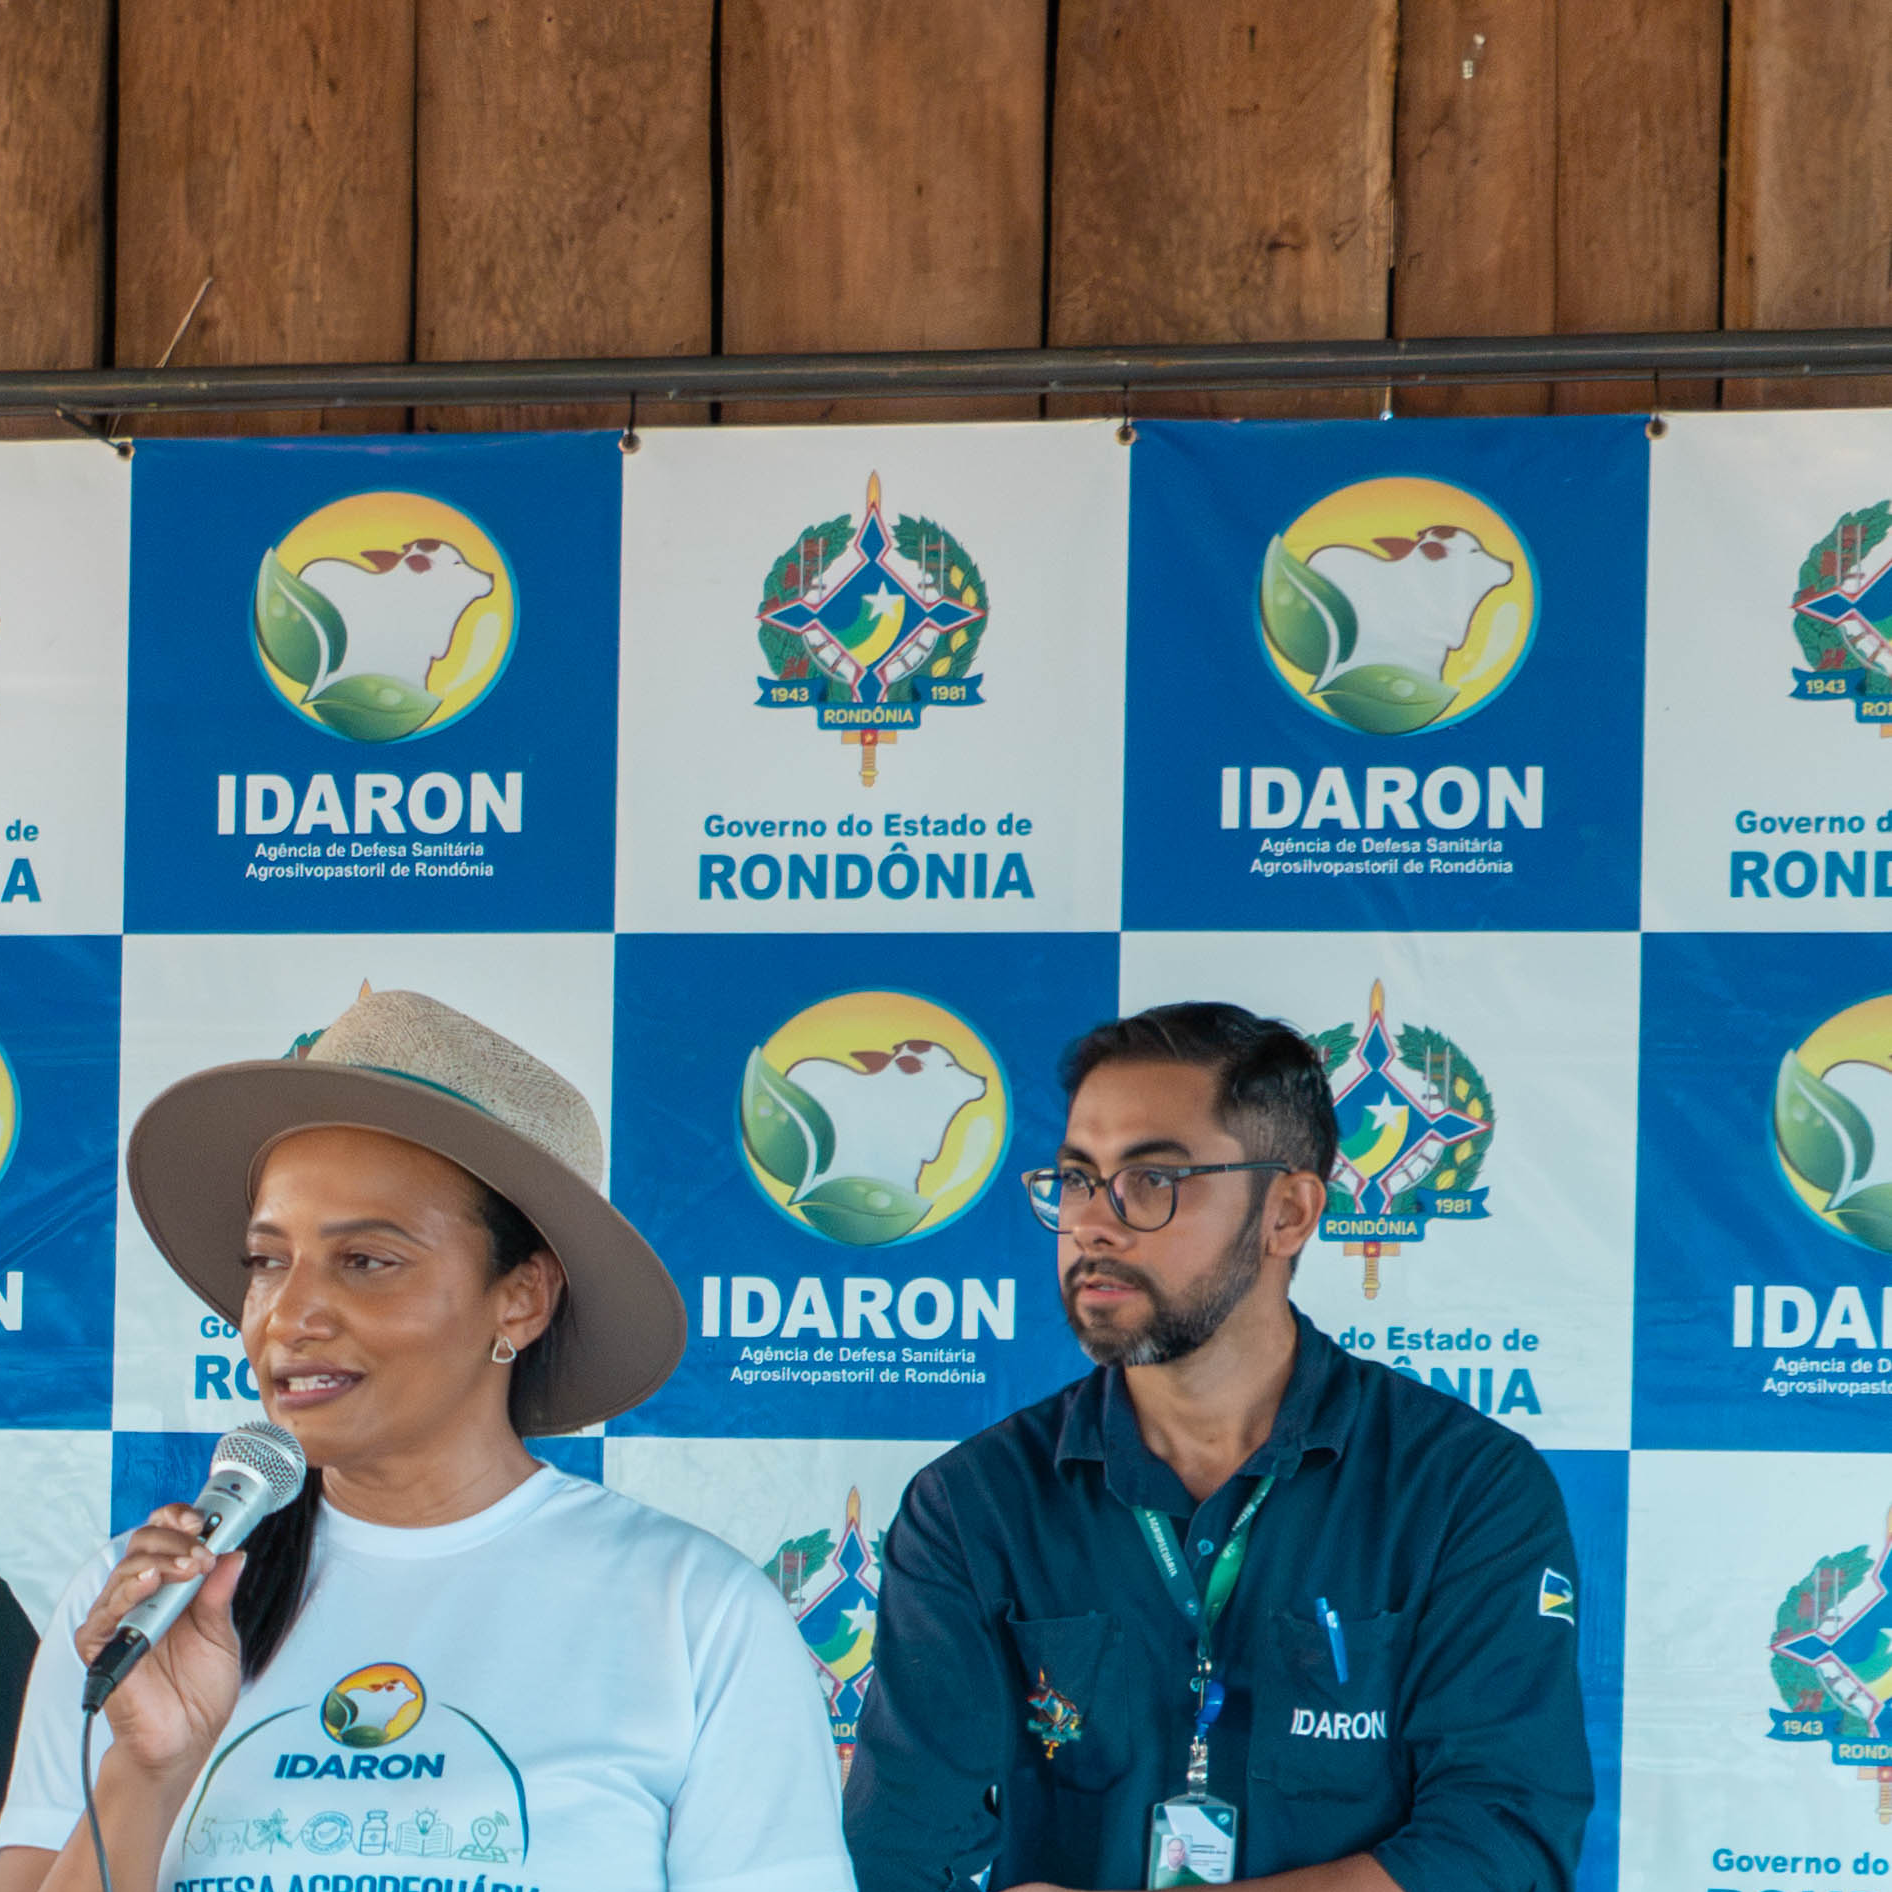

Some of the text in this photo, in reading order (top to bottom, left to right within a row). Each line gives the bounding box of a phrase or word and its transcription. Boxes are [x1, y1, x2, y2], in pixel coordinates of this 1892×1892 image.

[771, 687, 809, 702] 1943
[931, 685, 966, 700] 1981
[1806, 679, 1847, 694] 1943
[824, 705, 914, 724] RONDÔNIA
[218, 771, 523, 836] IDARON
[1220, 766, 1545, 831] IDARON
[6, 819, 40, 842] de
[704, 813, 1034, 839] Governo do Estado de
[1735, 810, 1892, 835] Governo d
[255, 840, 484, 862] Agência de Defesa Sanitária
[1260, 835, 1503, 858] Agência de Defesa Sanitária
[245, 861, 494, 883] Agrosilvopastoril de Rondônia
[698, 842, 1035, 902] RONDÔNIA
[1250, 857, 1513, 878] Agrosilvopastoril de Rondônia
[1436, 1198, 1472, 1213] 1981
[1326, 1217, 1418, 1236] RONDÔNIA
[701, 1276, 1016, 1340] IDARON
[1732, 1284, 1892, 1349] IDA
[1339, 1326, 1540, 1351] do Estado de
[740, 1345, 976, 1367] Agência de Defesa Sanitária
[1773, 1356, 1846, 1376] Agência
[1850, 1358, 1873, 1373] de
[730, 1365, 986, 1387] Agrosilvopastoril de Rondônia
[1290, 1707, 1388, 1741] IDARON
[1782, 1719, 1824, 1735] 1943
[1838, 1743, 1892, 1760] ROND
[273, 1753, 446, 1780] IDARON
[1712, 1847, 1890, 1876] Governo do
